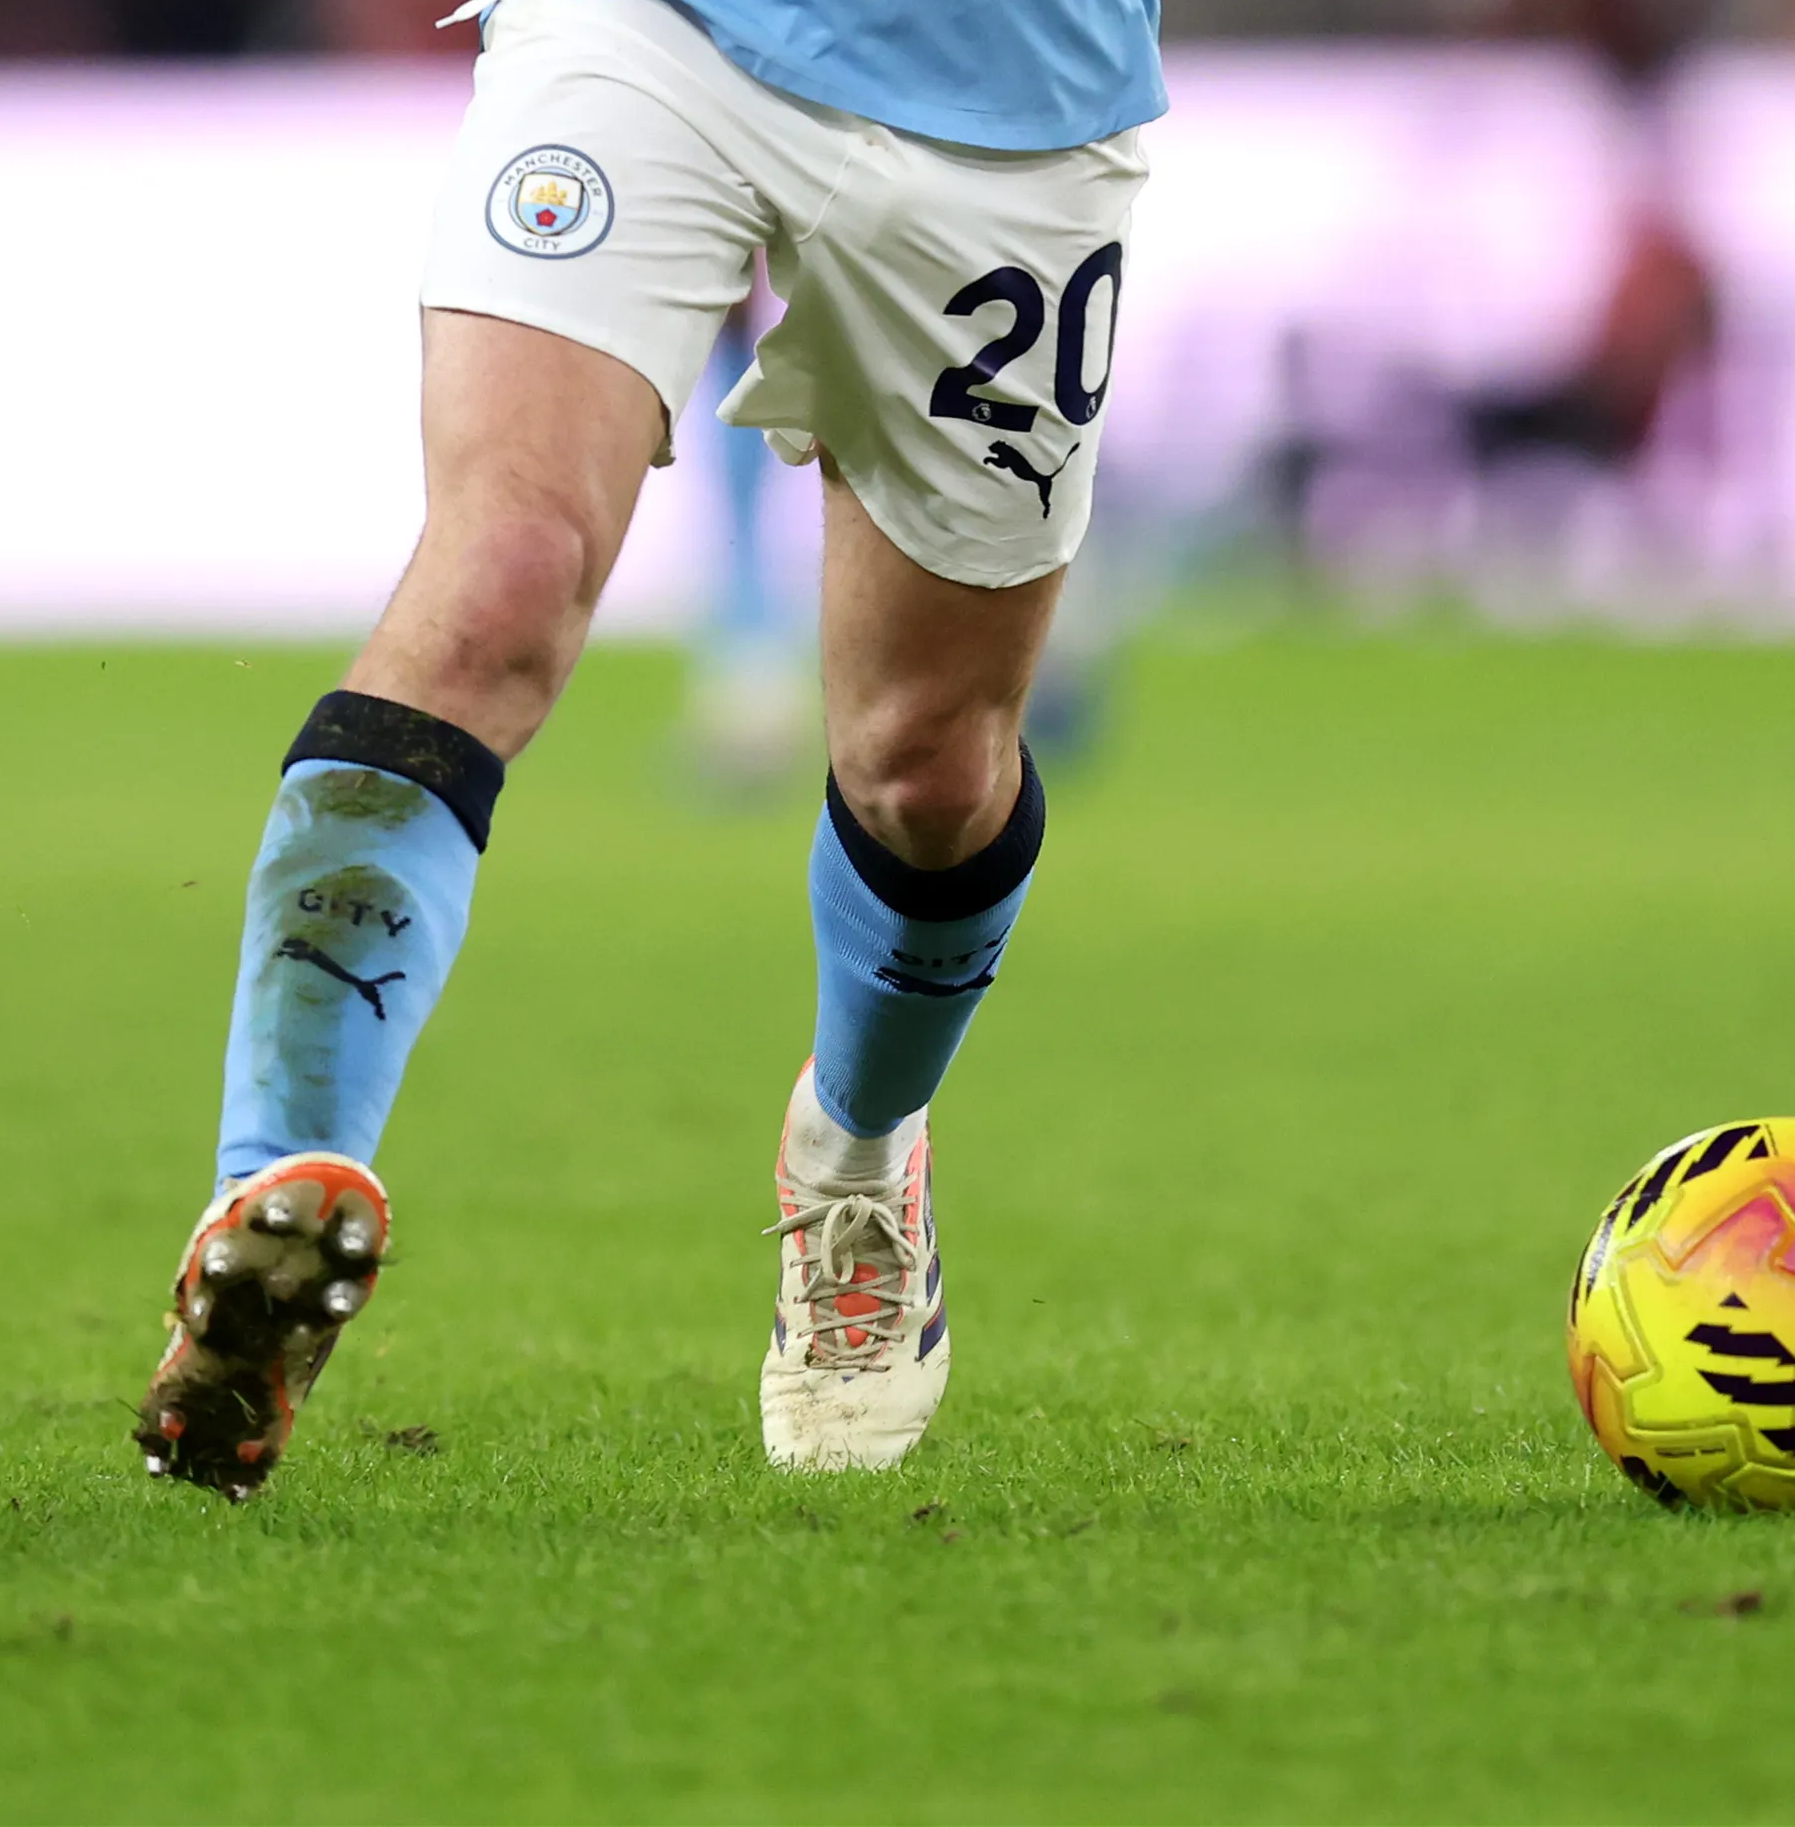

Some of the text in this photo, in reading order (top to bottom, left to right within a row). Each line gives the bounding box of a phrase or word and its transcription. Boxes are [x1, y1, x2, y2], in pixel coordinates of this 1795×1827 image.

[505, 154, 603, 197] MANCHESTER
[523, 237, 561, 251] CITY
[929, 241, 1123, 433] 20
